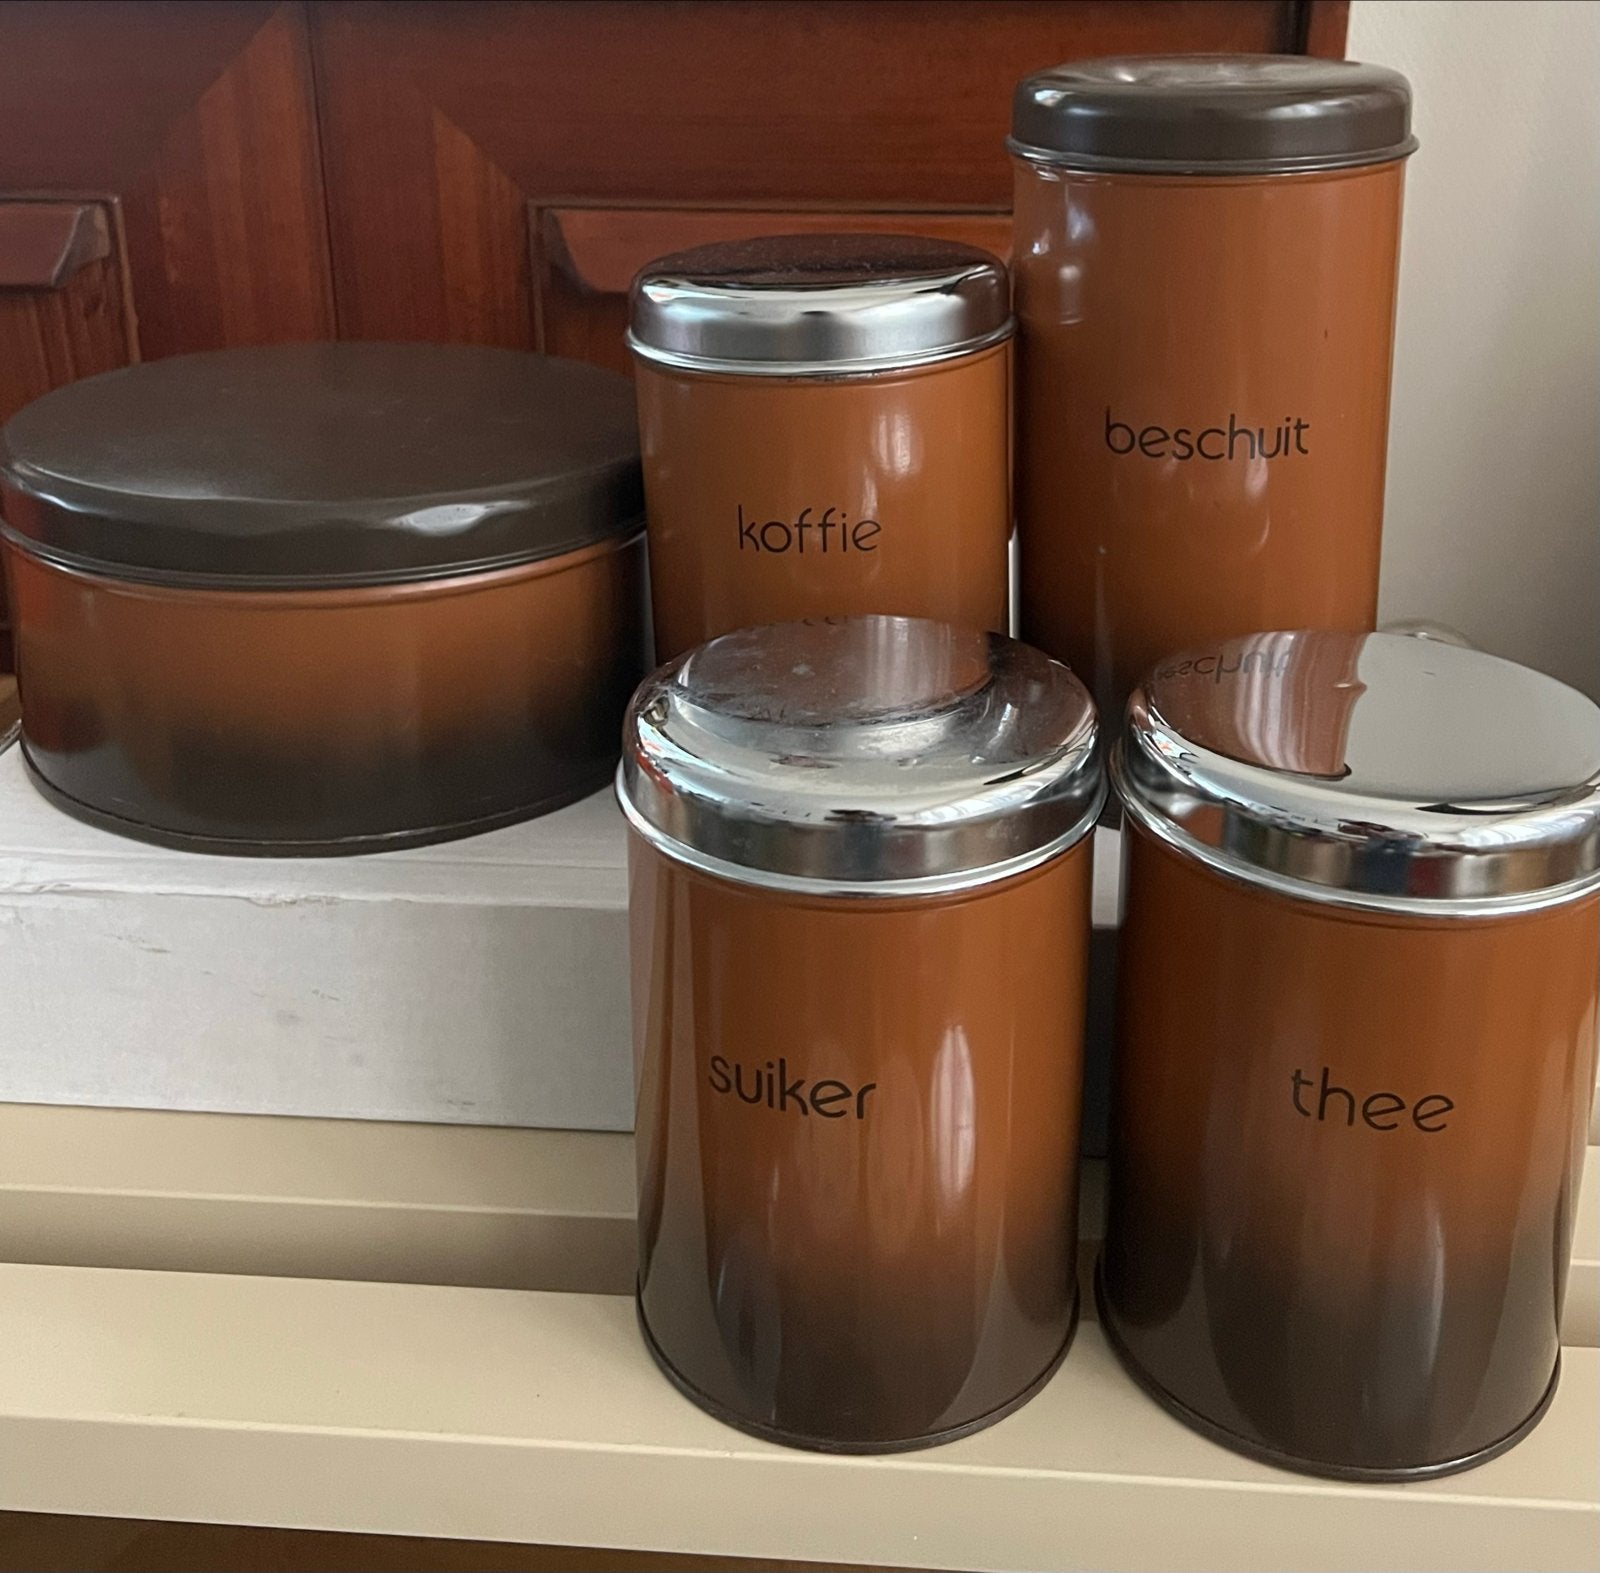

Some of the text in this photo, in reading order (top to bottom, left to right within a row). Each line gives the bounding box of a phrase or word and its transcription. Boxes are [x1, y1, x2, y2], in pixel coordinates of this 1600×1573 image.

[1105, 406, 1311, 461] beschuit
[738, 505, 882, 554] koffie
[708, 1056, 877, 1120] suiker
[1291, 1067, 1455, 1132] thee
